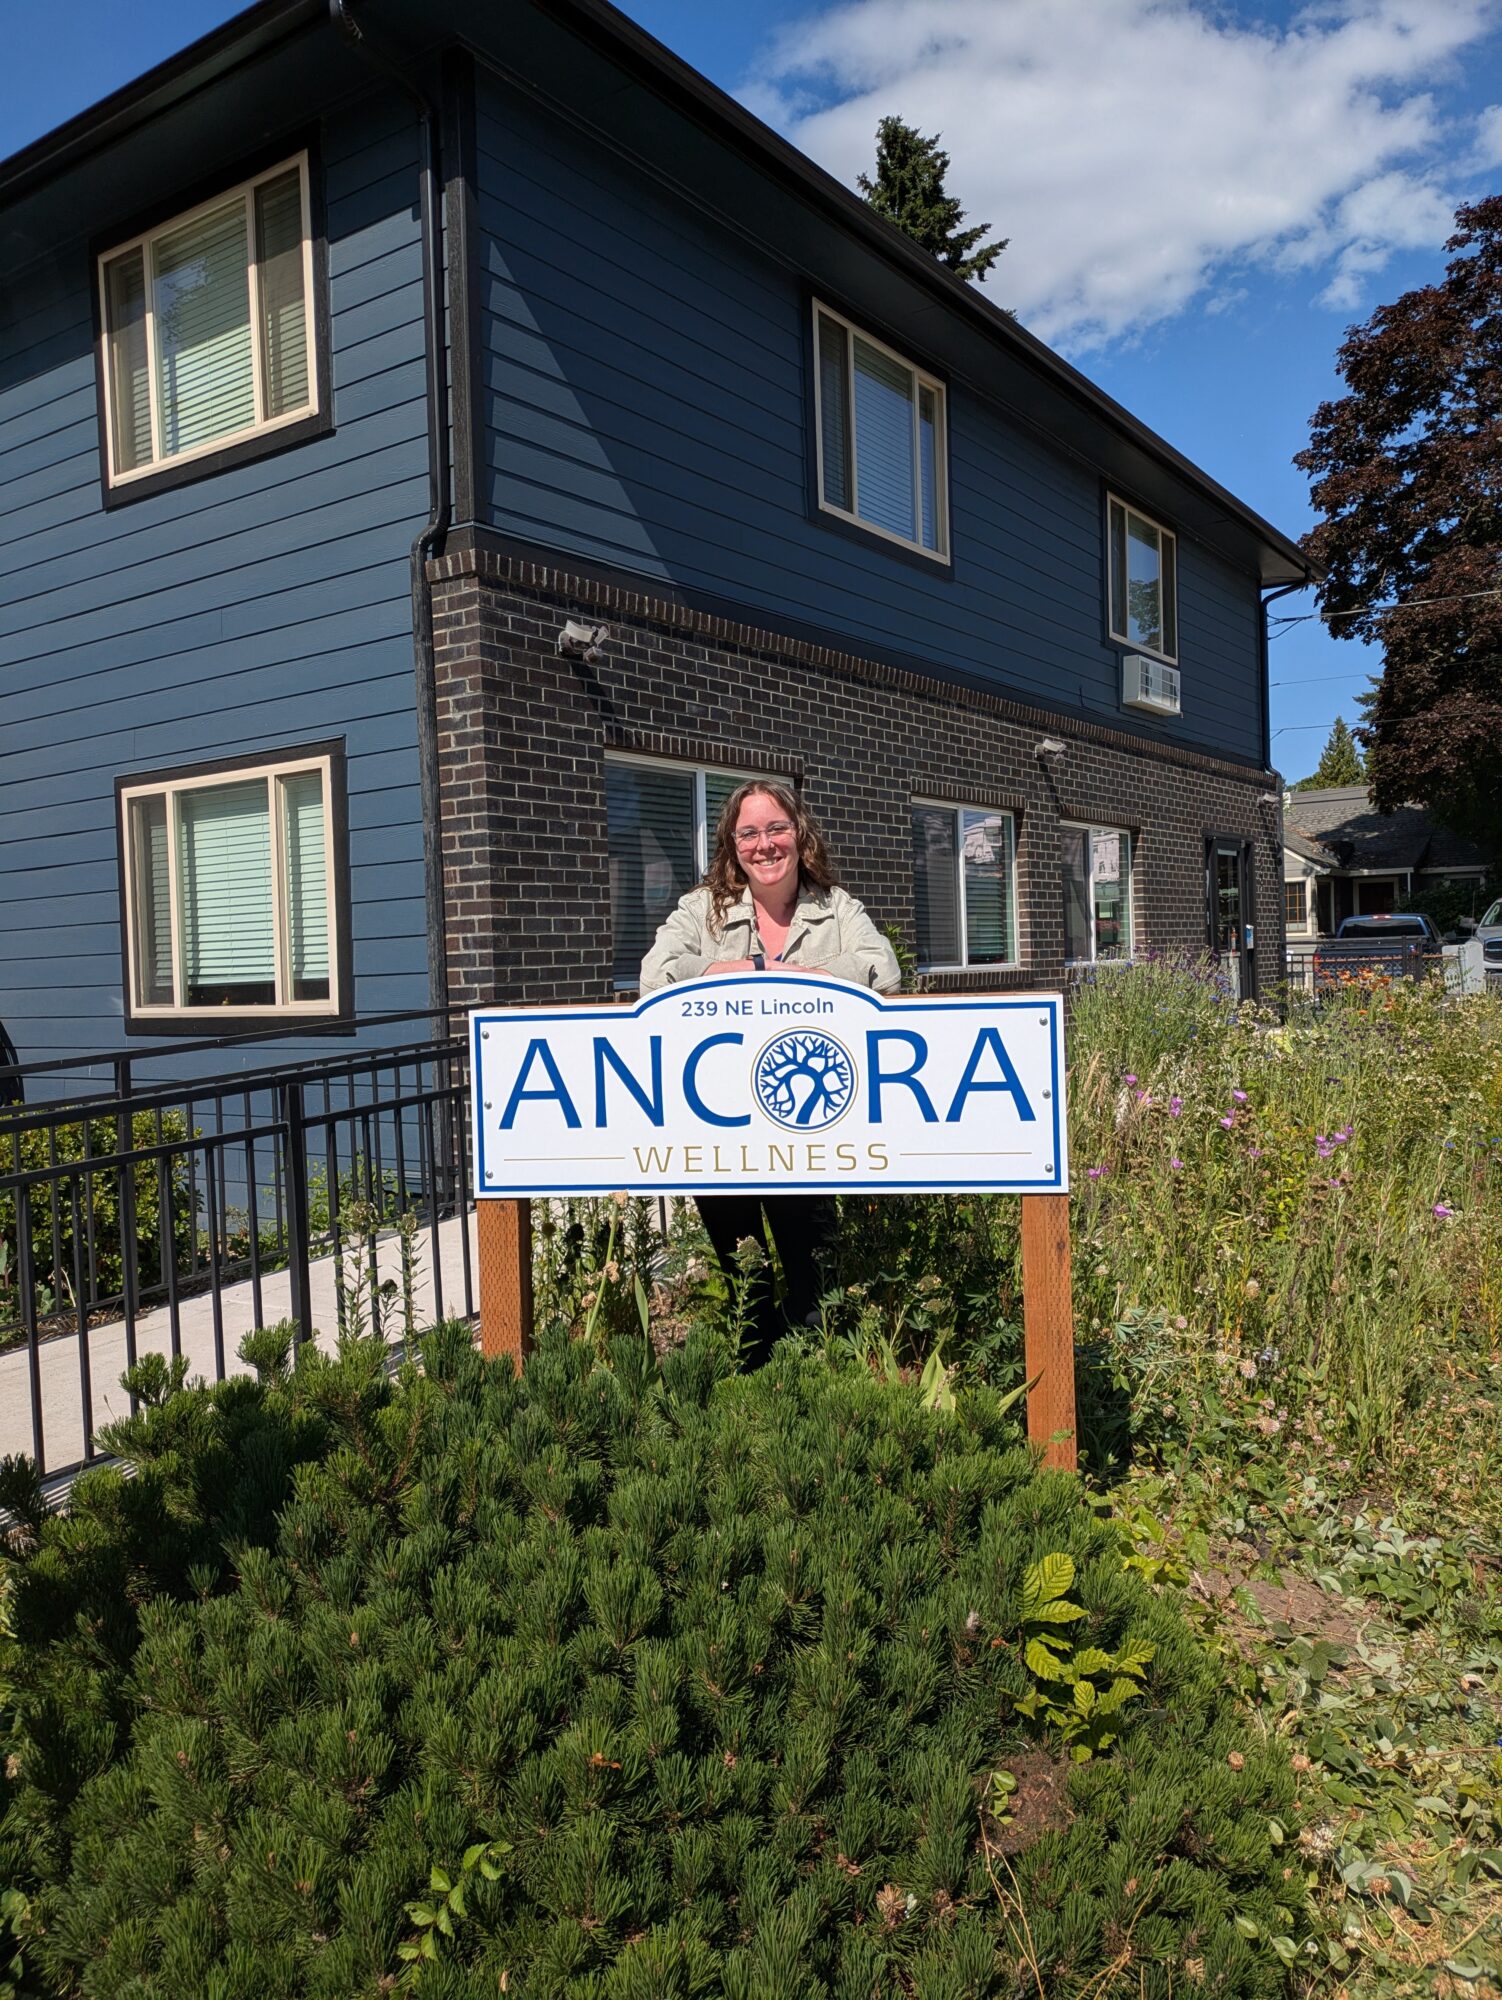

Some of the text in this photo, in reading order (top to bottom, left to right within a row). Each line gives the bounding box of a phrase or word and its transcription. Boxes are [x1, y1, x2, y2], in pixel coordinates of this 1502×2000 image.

[681, 997, 834, 1017] 239 NE Lincoln
[498, 1026, 1036, 1134] ANCORA
[633, 1144, 889, 1173] WELLNESS
